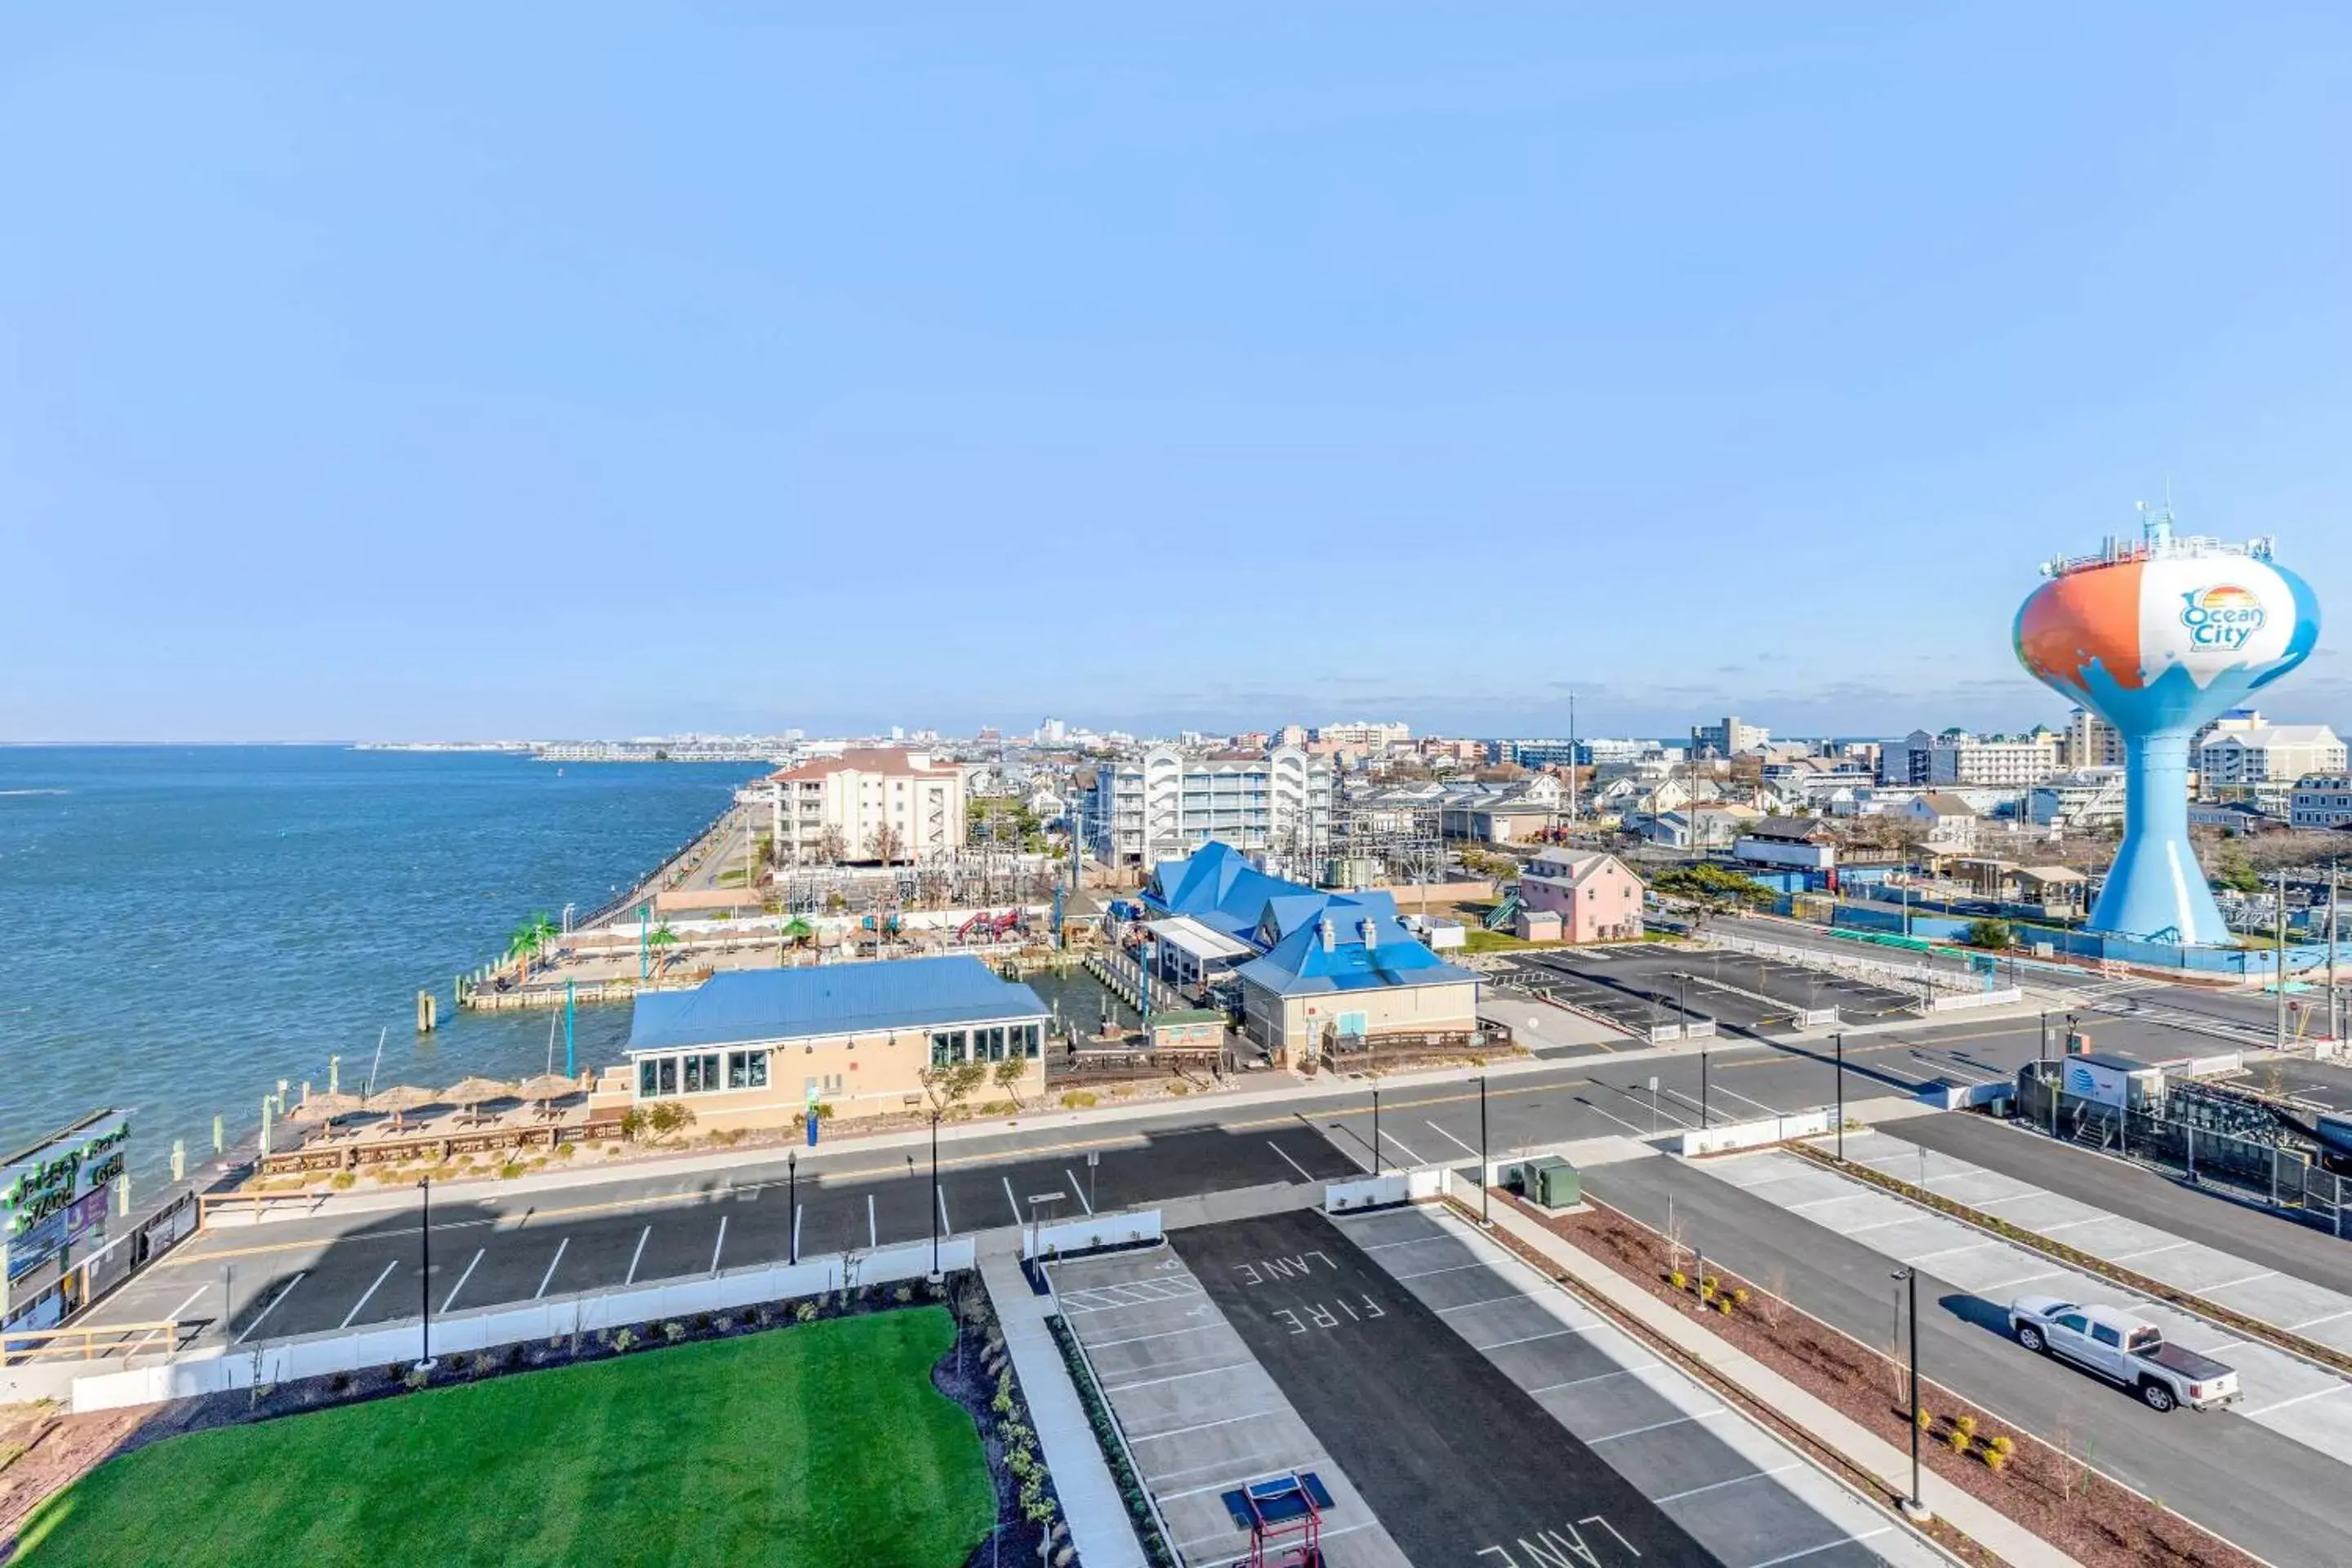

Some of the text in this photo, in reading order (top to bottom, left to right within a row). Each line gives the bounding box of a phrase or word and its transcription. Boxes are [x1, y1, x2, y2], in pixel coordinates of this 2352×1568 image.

[2184, 605, 2265, 627] Ocean
[2194, 624, 2252, 648] City
[1233, 1250, 1339, 1285] LANE
[1272, 1294, 1386, 1334] FIRE
